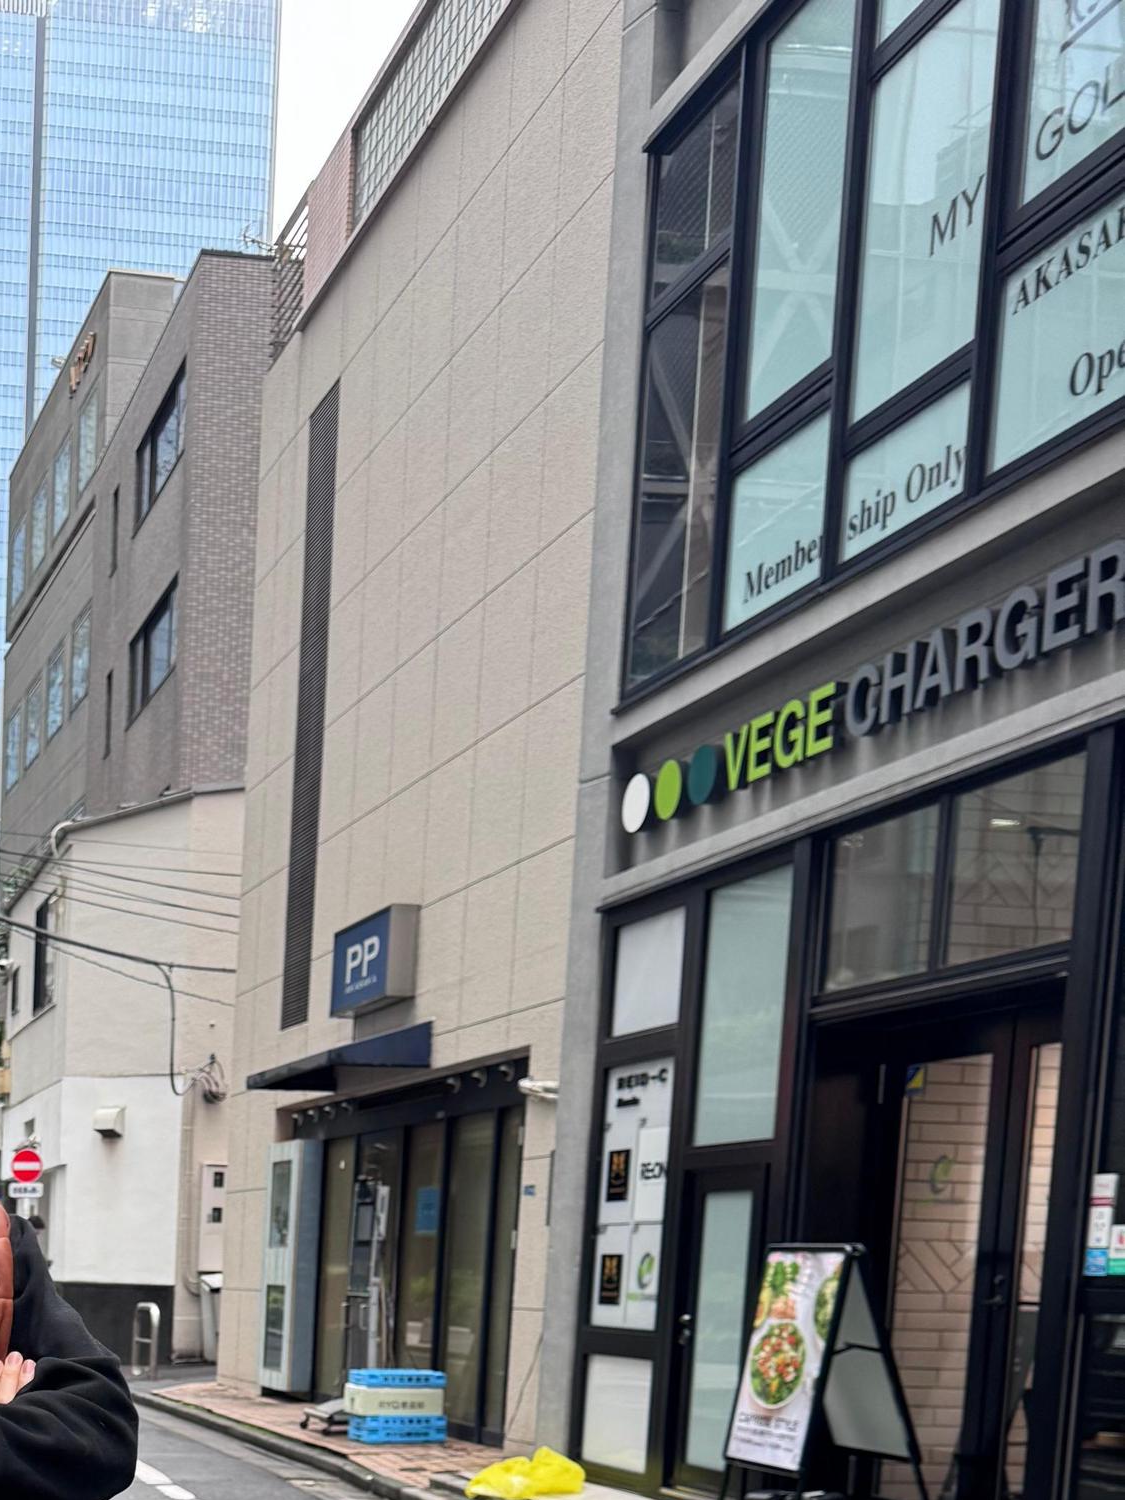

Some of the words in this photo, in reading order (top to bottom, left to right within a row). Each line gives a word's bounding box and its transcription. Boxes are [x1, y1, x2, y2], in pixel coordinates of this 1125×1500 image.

[929, 174, 985, 258] MY
[906, 444, 967, 504] Only
[724, 682, 837, 791] VEGE
[845, 540, 1125, 738] CHARGER
[345, 935, 381, 985] PP
